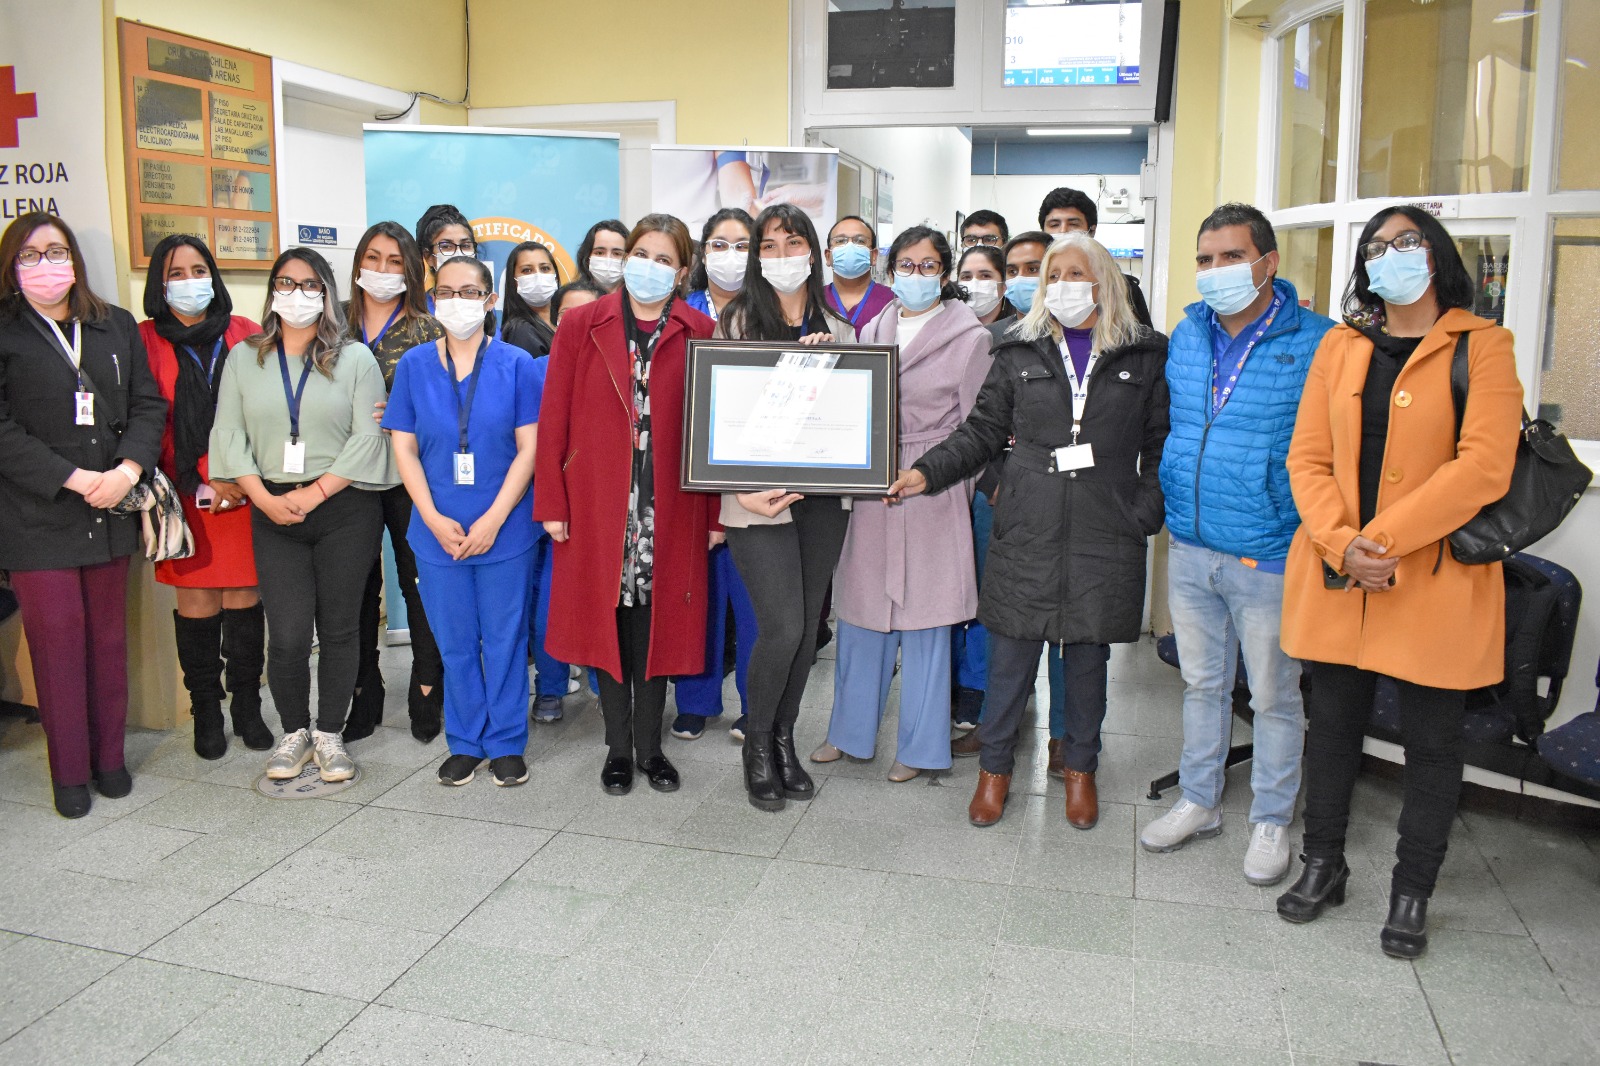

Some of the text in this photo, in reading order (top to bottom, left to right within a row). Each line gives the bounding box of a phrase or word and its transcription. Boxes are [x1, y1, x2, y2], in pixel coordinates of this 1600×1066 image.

[210, 56, 238, 71] CHILENA
[214, 70, 241, 84] ARENAS
[15, 162, 69, 185] ROJA
